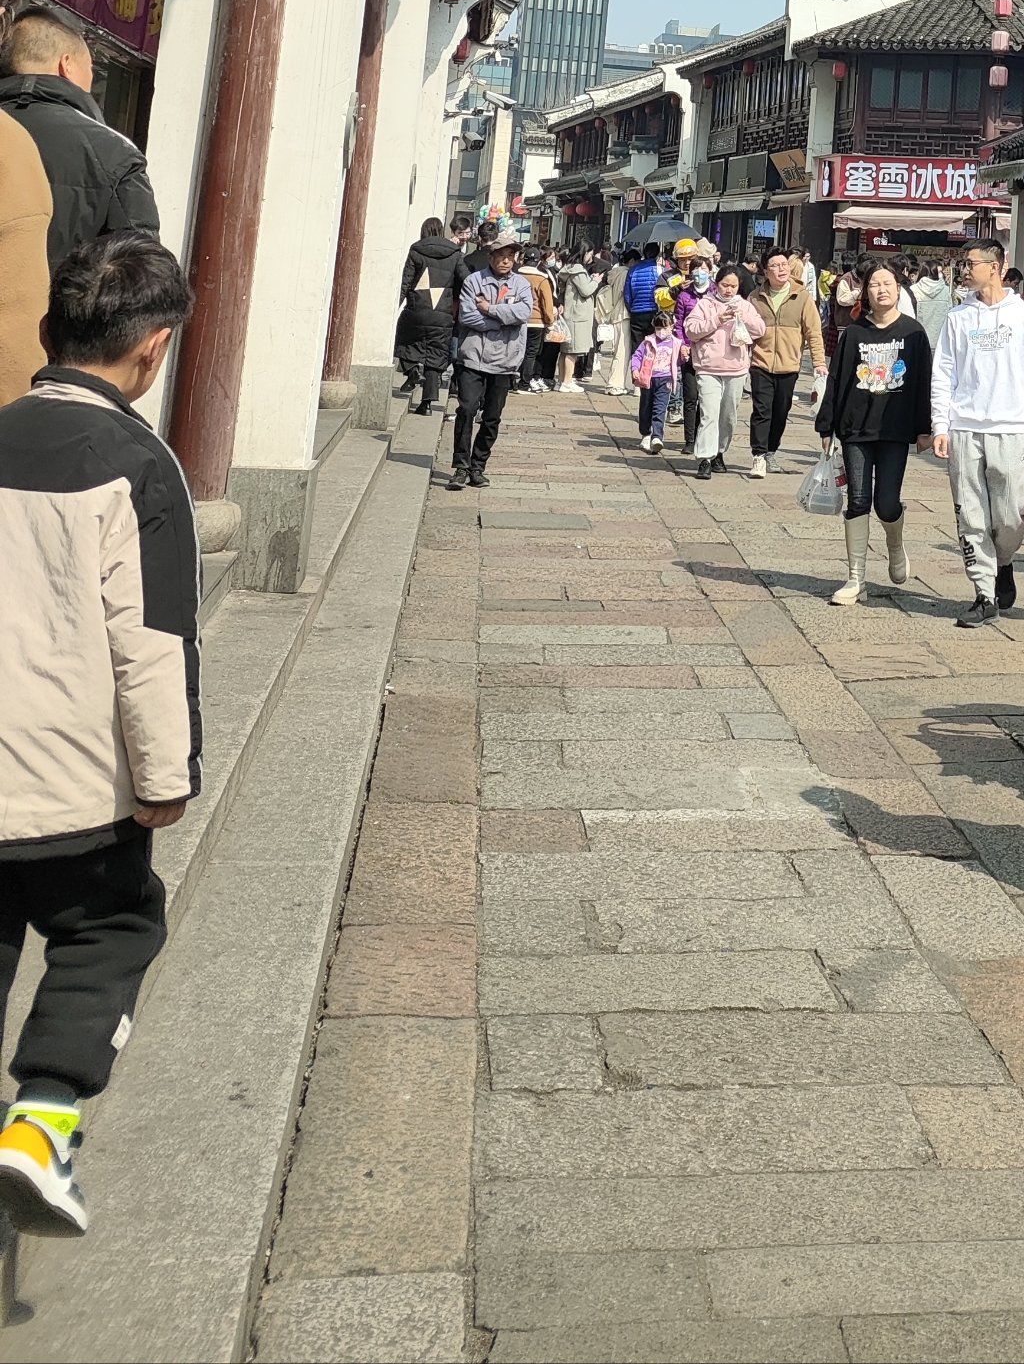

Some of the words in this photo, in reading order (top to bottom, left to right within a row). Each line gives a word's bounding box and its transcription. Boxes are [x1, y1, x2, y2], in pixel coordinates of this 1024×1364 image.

[844, 160, 976, 200] 蜜雪冰城
[858, 338, 905, 353] Surrounded
